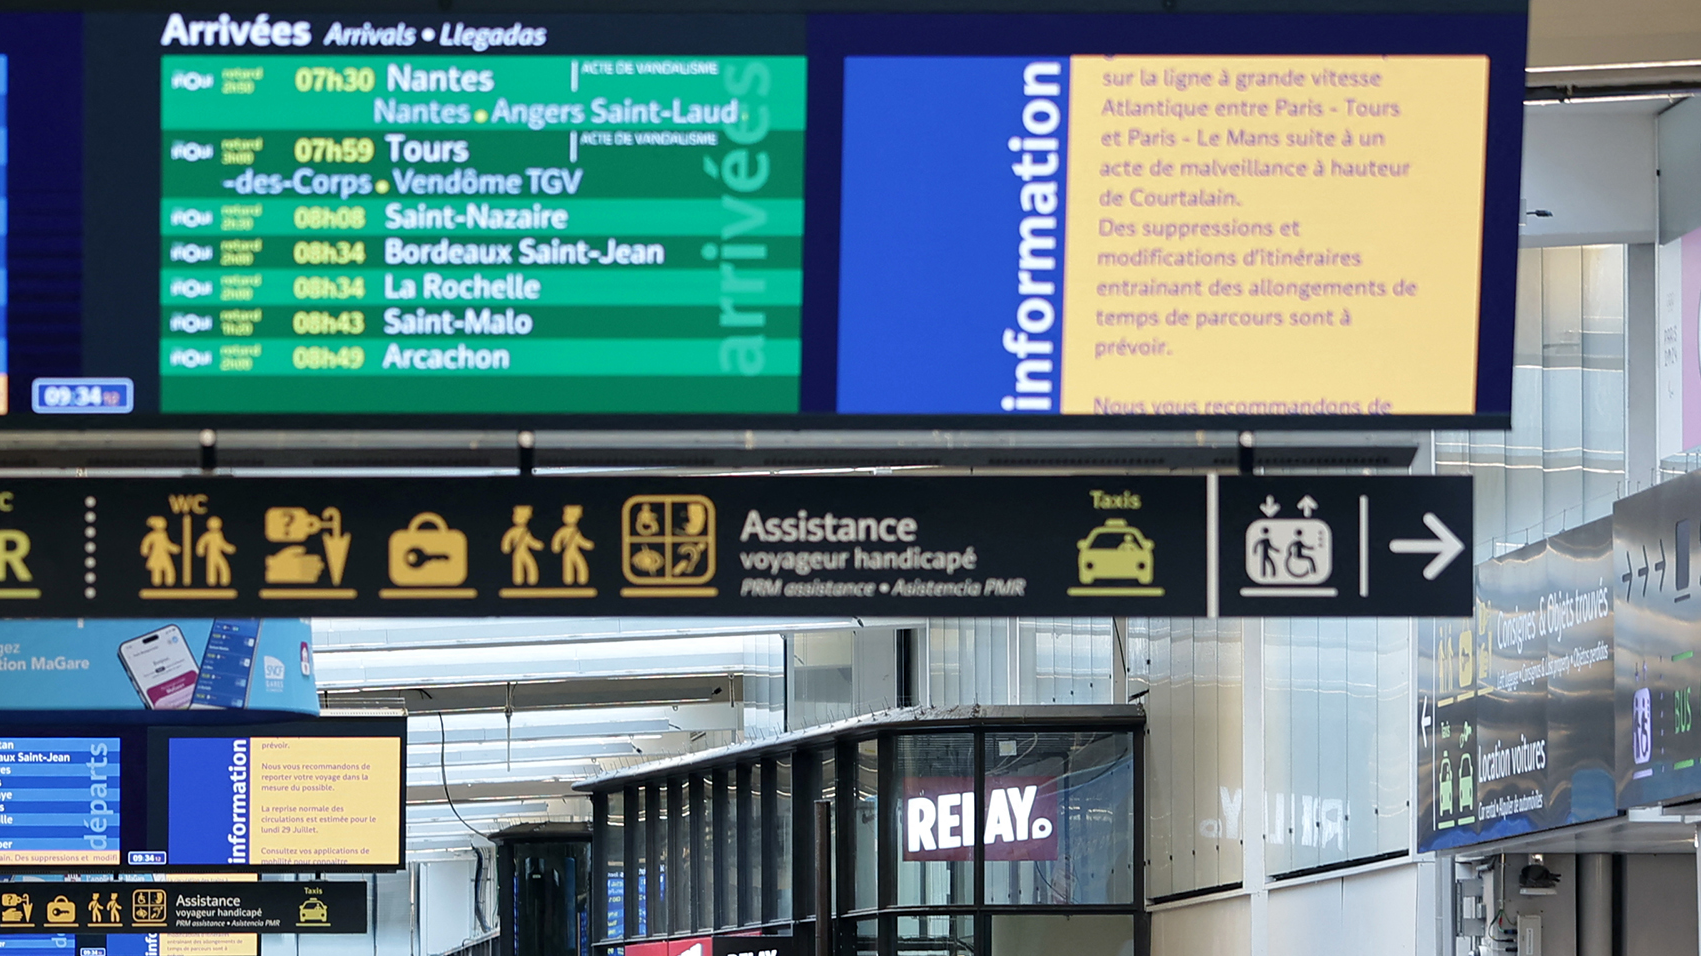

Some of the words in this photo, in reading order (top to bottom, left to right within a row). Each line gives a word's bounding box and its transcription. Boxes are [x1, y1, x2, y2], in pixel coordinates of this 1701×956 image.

[161, 13, 311, 46] Arrivées
[323, 22, 416, 46] Arrivals
[439, 22, 547, 52] Llegadas
[295, 68, 374, 92] 07h30
[387, 64, 495, 92] Nantes
[1103, 73, 1134, 86] sur
[1141, 70, 1158, 86] la
[1164, 68, 1214, 91] ligne
[1218, 70, 1231, 86] à
[1235, 69, 1306, 92] grande
[1311, 68, 1383, 87] vitesse
[374, 98, 471, 124] Nantes
[491, 98, 585, 130] Angers
[591, 98, 739, 124] Saint-Laud
[295, 138, 374, 162] 07h59
[385, 134, 469, 162] Tours
[223, 168, 373, 199] -des-Corps
[393, 168, 522, 194] Vendôme
[525, 168, 583, 194] TGV
[295, 207, 365, 228] 08h08
[385, 203, 568, 229] Saint-Nazaire
[701, 61, 769, 376] arrivées
[1099, 218, 1137, 236] Des
[1143, 219, 1275, 240] suppressions
[1280, 221, 1300, 236] et
[1000, 61, 1061, 412] information
[1098, 248, 1237, 266] modifications
[1243, 248, 1363, 266] d'itinéraires
[293, 347, 364, 368] 08h49
[382, 343, 510, 369] Arcachon
[1095, 338, 1173, 359] prévoir.
[166, 494, 211, 515] WC
[1089, 490, 1141, 509] Taxis
[740, 510, 917, 542] Assistance
[740, 552, 849, 575] voyageur
[855, 547, 977, 574] handicapé
[1498, 606, 1536, 654] Consignes
[1539, 595, 1548, 637] &
[1547, 588, 1574, 642] Objets
[1575, 577, 1609, 625] trouvés
[31, 656, 89, 670] MaGare
[1674, 687, 1693, 734] BUS
[1478, 738, 1511, 783] Location
[1511, 733, 1546, 775] voitures
[228, 739, 247, 864] information
[176, 895, 240, 906] Assistance
